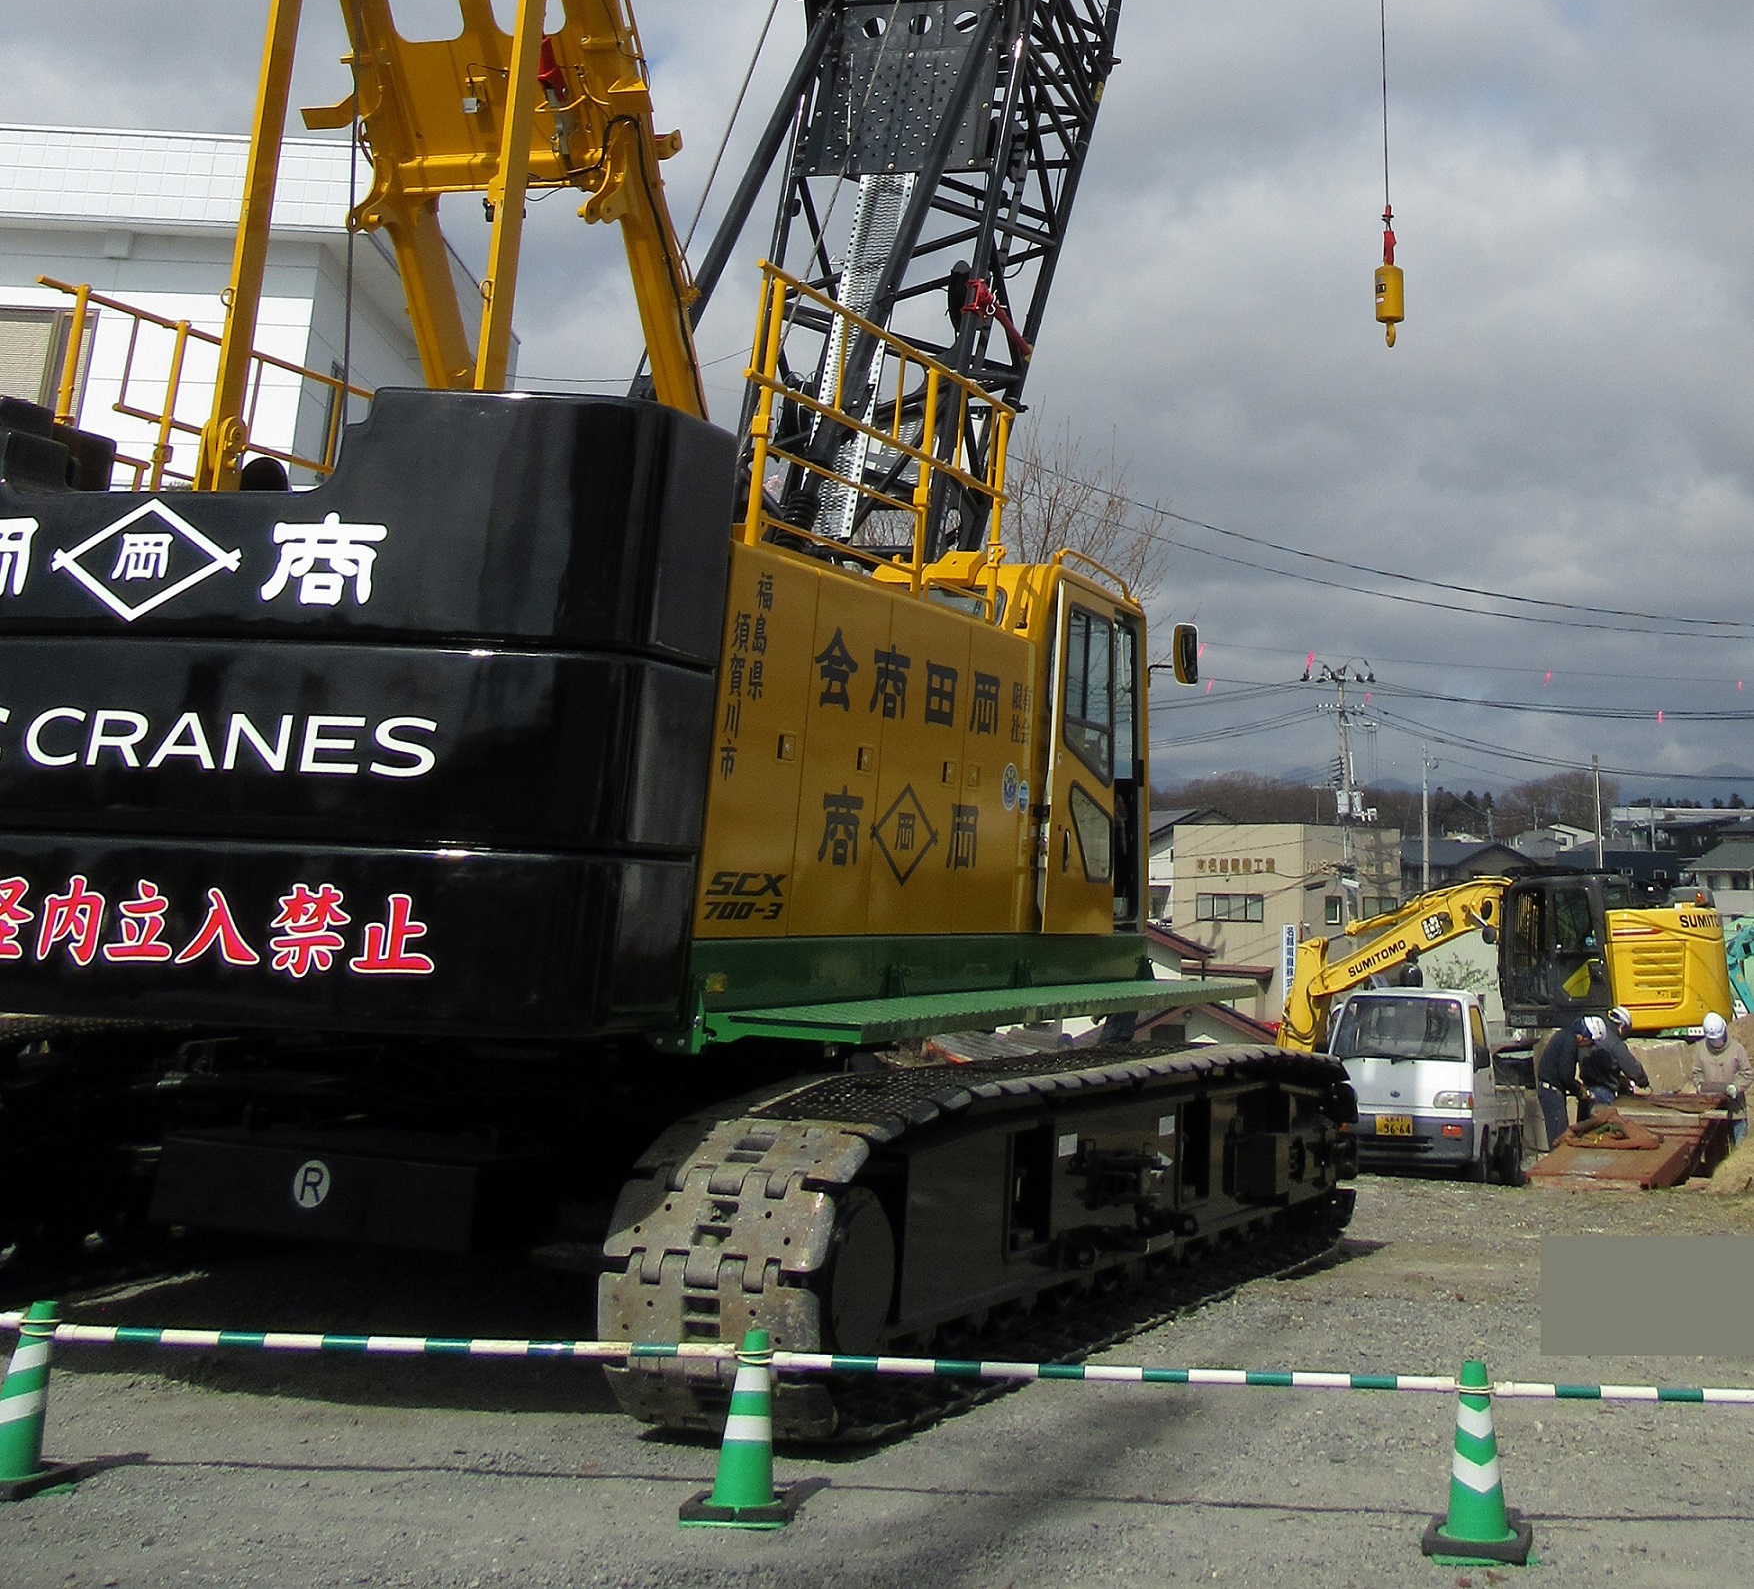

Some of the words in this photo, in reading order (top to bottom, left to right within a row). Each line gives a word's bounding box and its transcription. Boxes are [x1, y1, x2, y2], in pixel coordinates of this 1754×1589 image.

[260, 512, 388, 605] 商
[746, 571, 774, 702] 福島県
[719, 610, 752, 783] 須賀川市
[25, 706, 438, 778] CRANES
[817, 784, 864, 867] 商
[703, 901, 784, 921] 700-3
[704, 871, 788, 898] SCX
[1347, 939, 1407, 978] SUMITOMO
[301, 1167, 323, 1203] R
